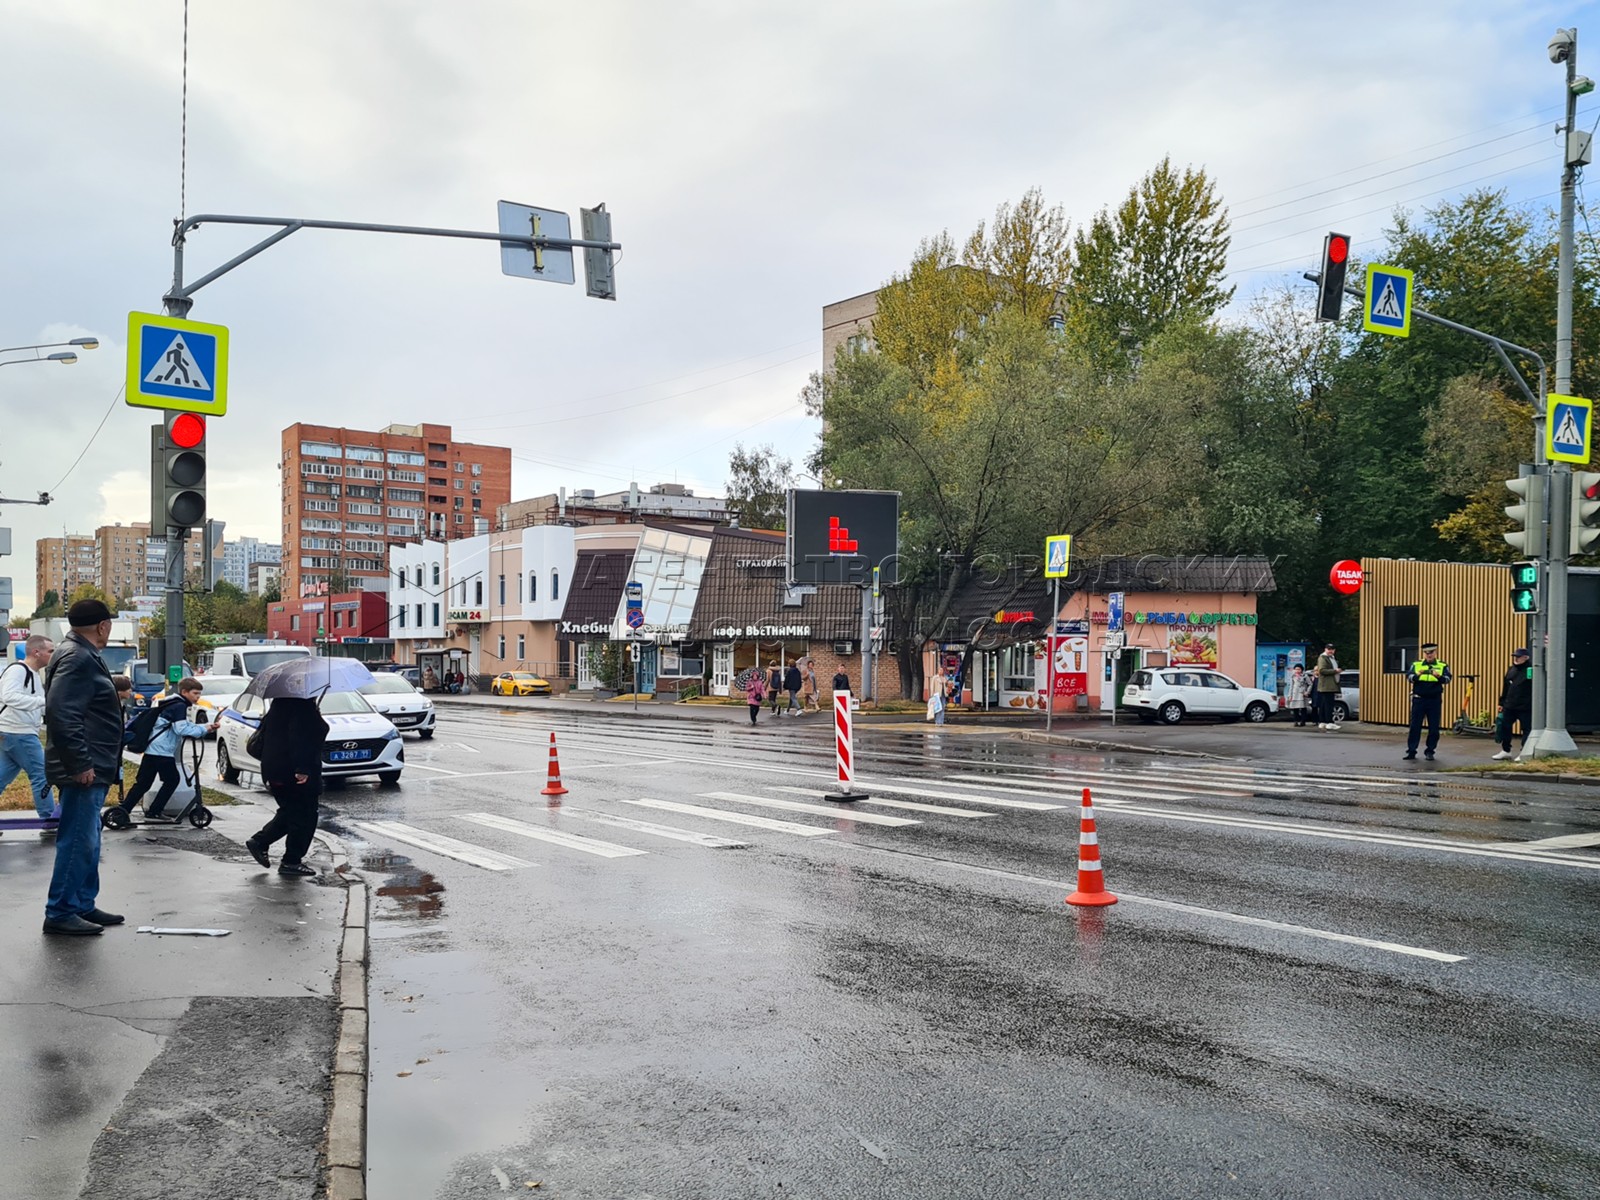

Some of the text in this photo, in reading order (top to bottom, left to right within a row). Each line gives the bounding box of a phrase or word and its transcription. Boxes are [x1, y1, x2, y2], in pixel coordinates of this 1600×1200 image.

[1336, 570, 1362, 579] ТАБАК
[1523, 567, 1536, 582] 18
[469, 611, 482, 620] 24
[1147, 612, 1187, 624] РЫБА
[1201, 612, 1258, 625] ФРУКТЫ
[643, 624, 689, 633] ОФЕЙНЯ
[713, 625, 742, 638] кафе
[326, 716, 371, 724] ПС
[340, 750, 358, 759] 3287
